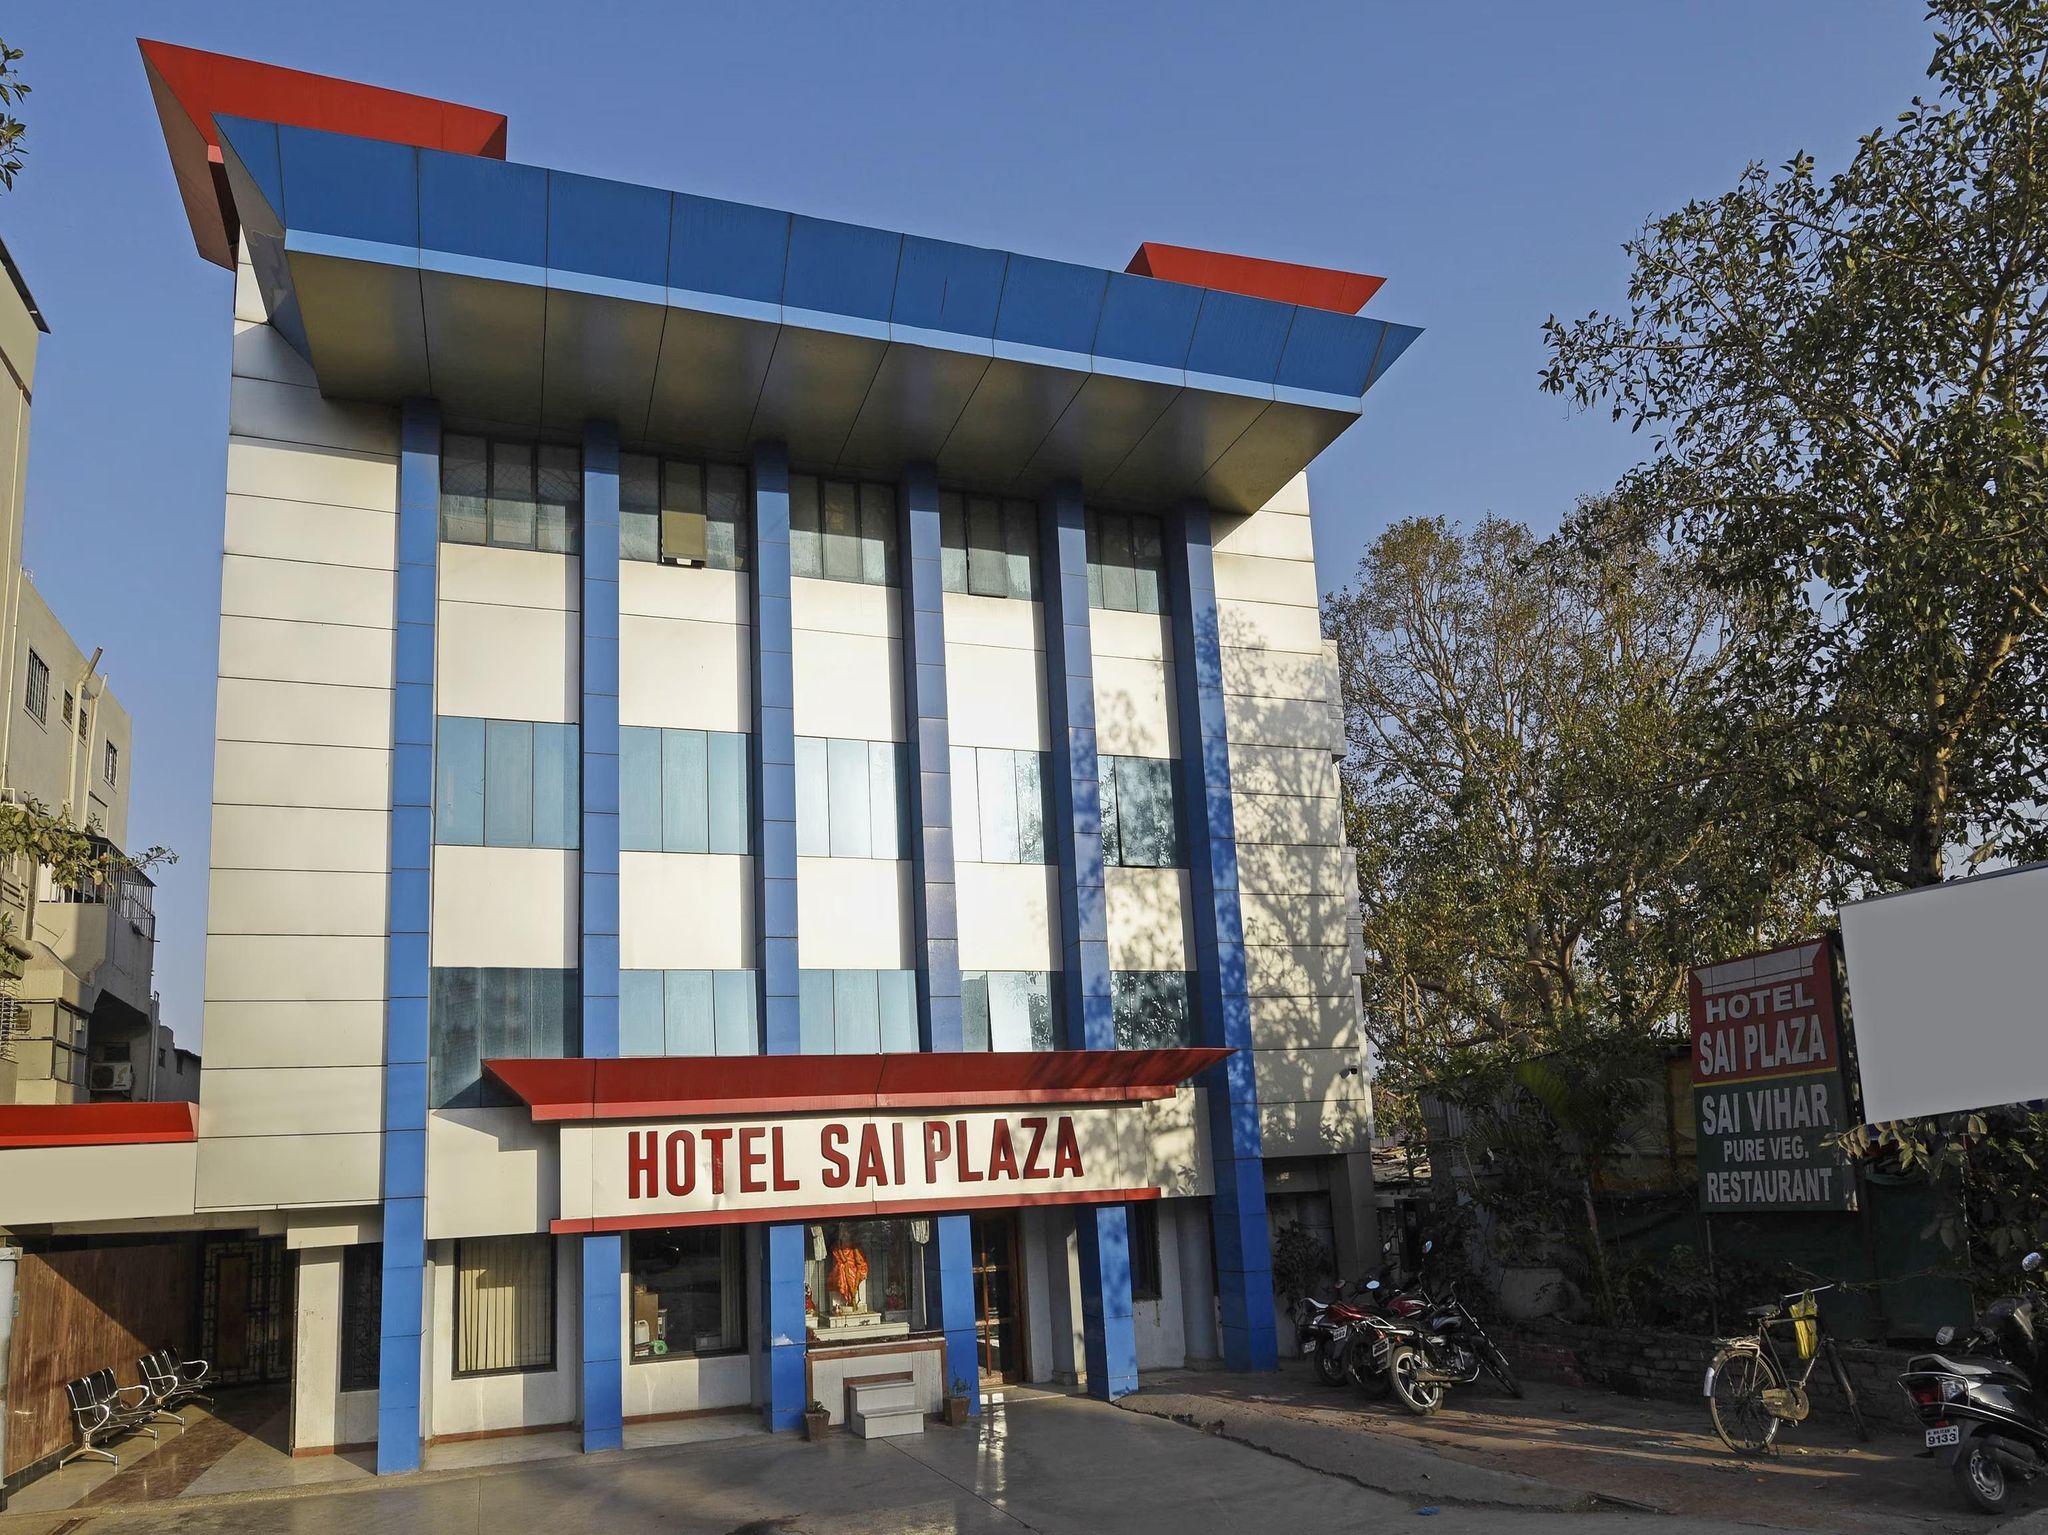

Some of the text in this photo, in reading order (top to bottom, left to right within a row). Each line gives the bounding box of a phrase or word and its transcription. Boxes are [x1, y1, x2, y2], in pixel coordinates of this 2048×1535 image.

[1706, 983, 1814, 1023] HOTEL
[1700, 1014, 1827, 1075] SAI PLAZA
[1702, 1083, 1831, 1135] SAI VIHAR
[627, 1115, 1085, 1199] HOTEL SAI PLAZA
[1723, 1135, 1810, 1163] PURE VEG.
[1706, 1167, 1833, 1203] RESTAURANT
[1928, 1433, 1957, 1445] 9133
